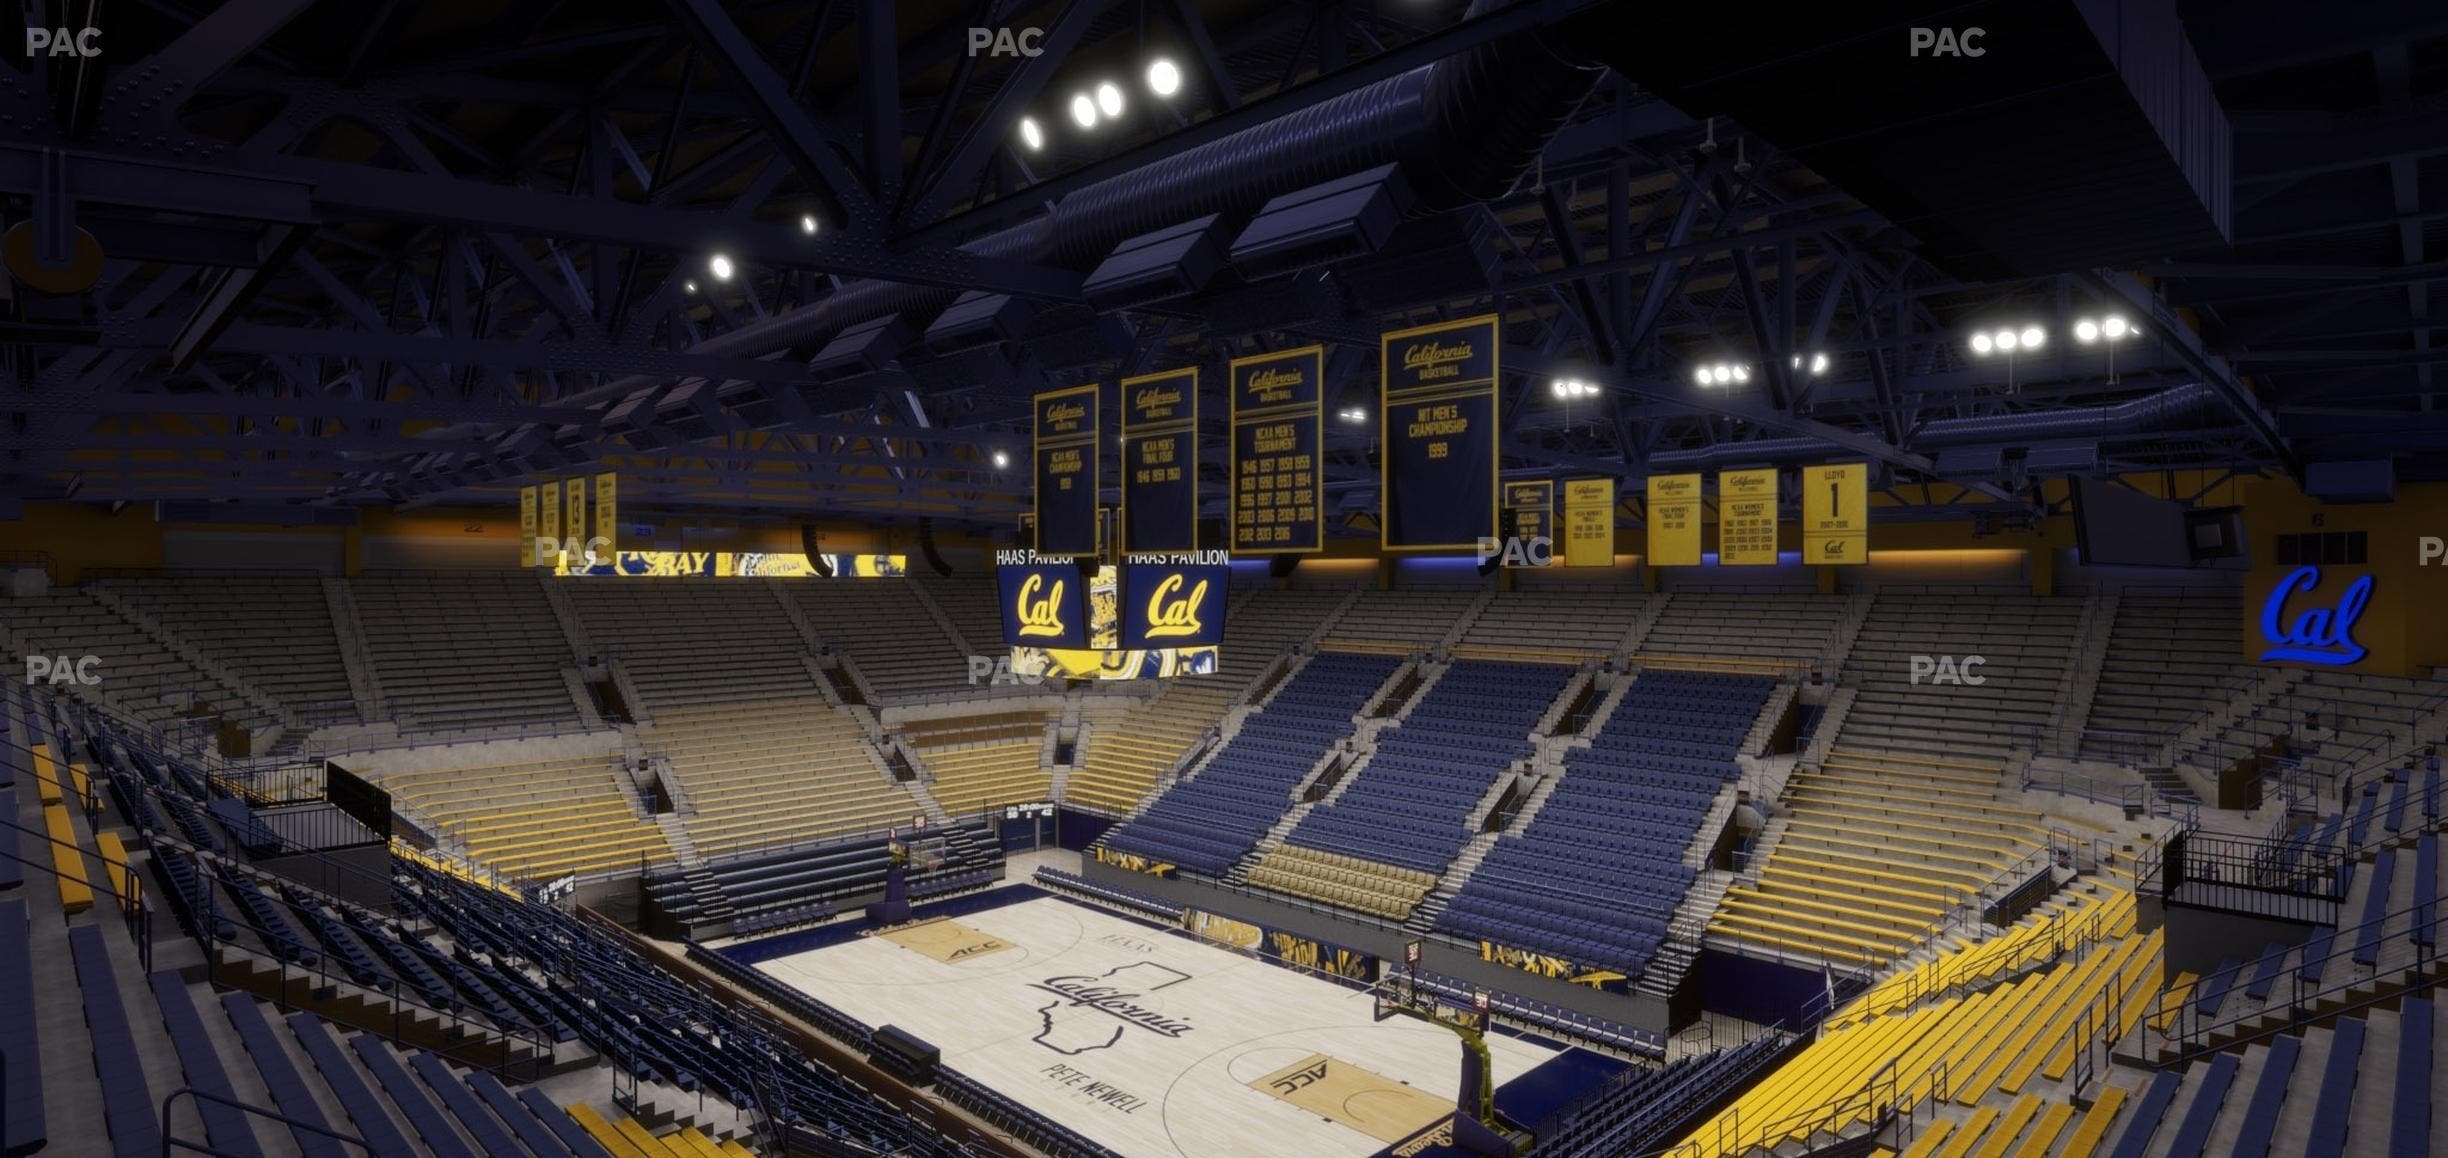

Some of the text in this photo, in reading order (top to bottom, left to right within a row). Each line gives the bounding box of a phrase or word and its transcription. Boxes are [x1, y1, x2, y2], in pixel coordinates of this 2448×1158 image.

[1403, 340, 1473, 370] California
[1248, 368, 1303, 394] California
[1419, 365, 1459, 380] BASKETBALL
[1136, 387, 1182, 410] California
[1046, 402, 1085, 423] California
[1418, 404, 1458, 421] NIT MEN'S
[1408, 418, 1468, 438] CHAMPIONSHIP
[1428, 441, 1448, 459] 1999
[1824, 470, 1845, 480] LLOYD
[1831, 482, 1838, 518] 1
[996, 549, 1026, 565] HAAS
[1171, 549, 1229, 565] PAVILION
[1824, 540, 1846, 554] Cal
[1017, 573, 1065, 637] Cal
[1144, 573, 1208, 639] Cal
[2260, 563, 2376, 666] Cal
[948, 940, 1001, 959] ACC
[1027, 976, 1194, 1037] California
[1271, 1060, 1328, 1095] ACC
[1040, 1063, 1091, 1087] PETE
[1080, 1081, 1148, 1115] NEWELL
